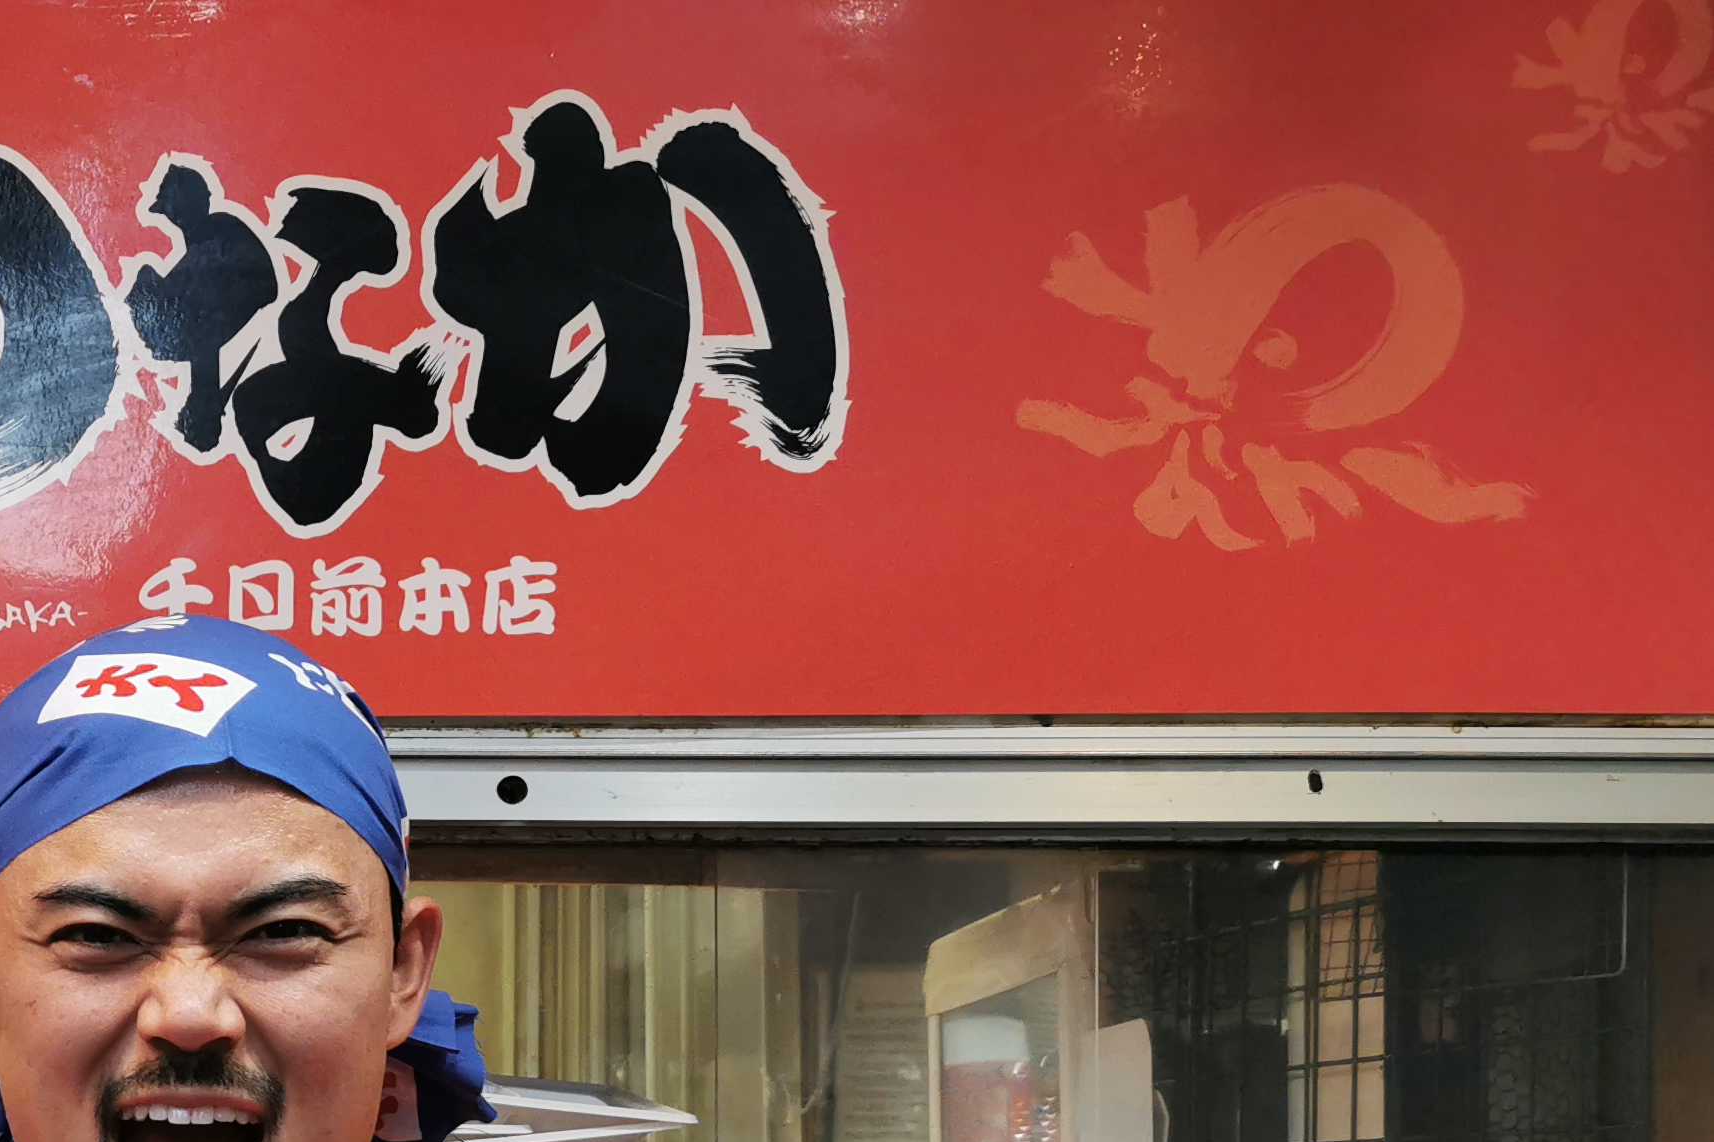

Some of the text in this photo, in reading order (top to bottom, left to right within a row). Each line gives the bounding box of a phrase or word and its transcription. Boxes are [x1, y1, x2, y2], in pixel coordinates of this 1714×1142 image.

[139, 555, 558, 637] 千日前本店
